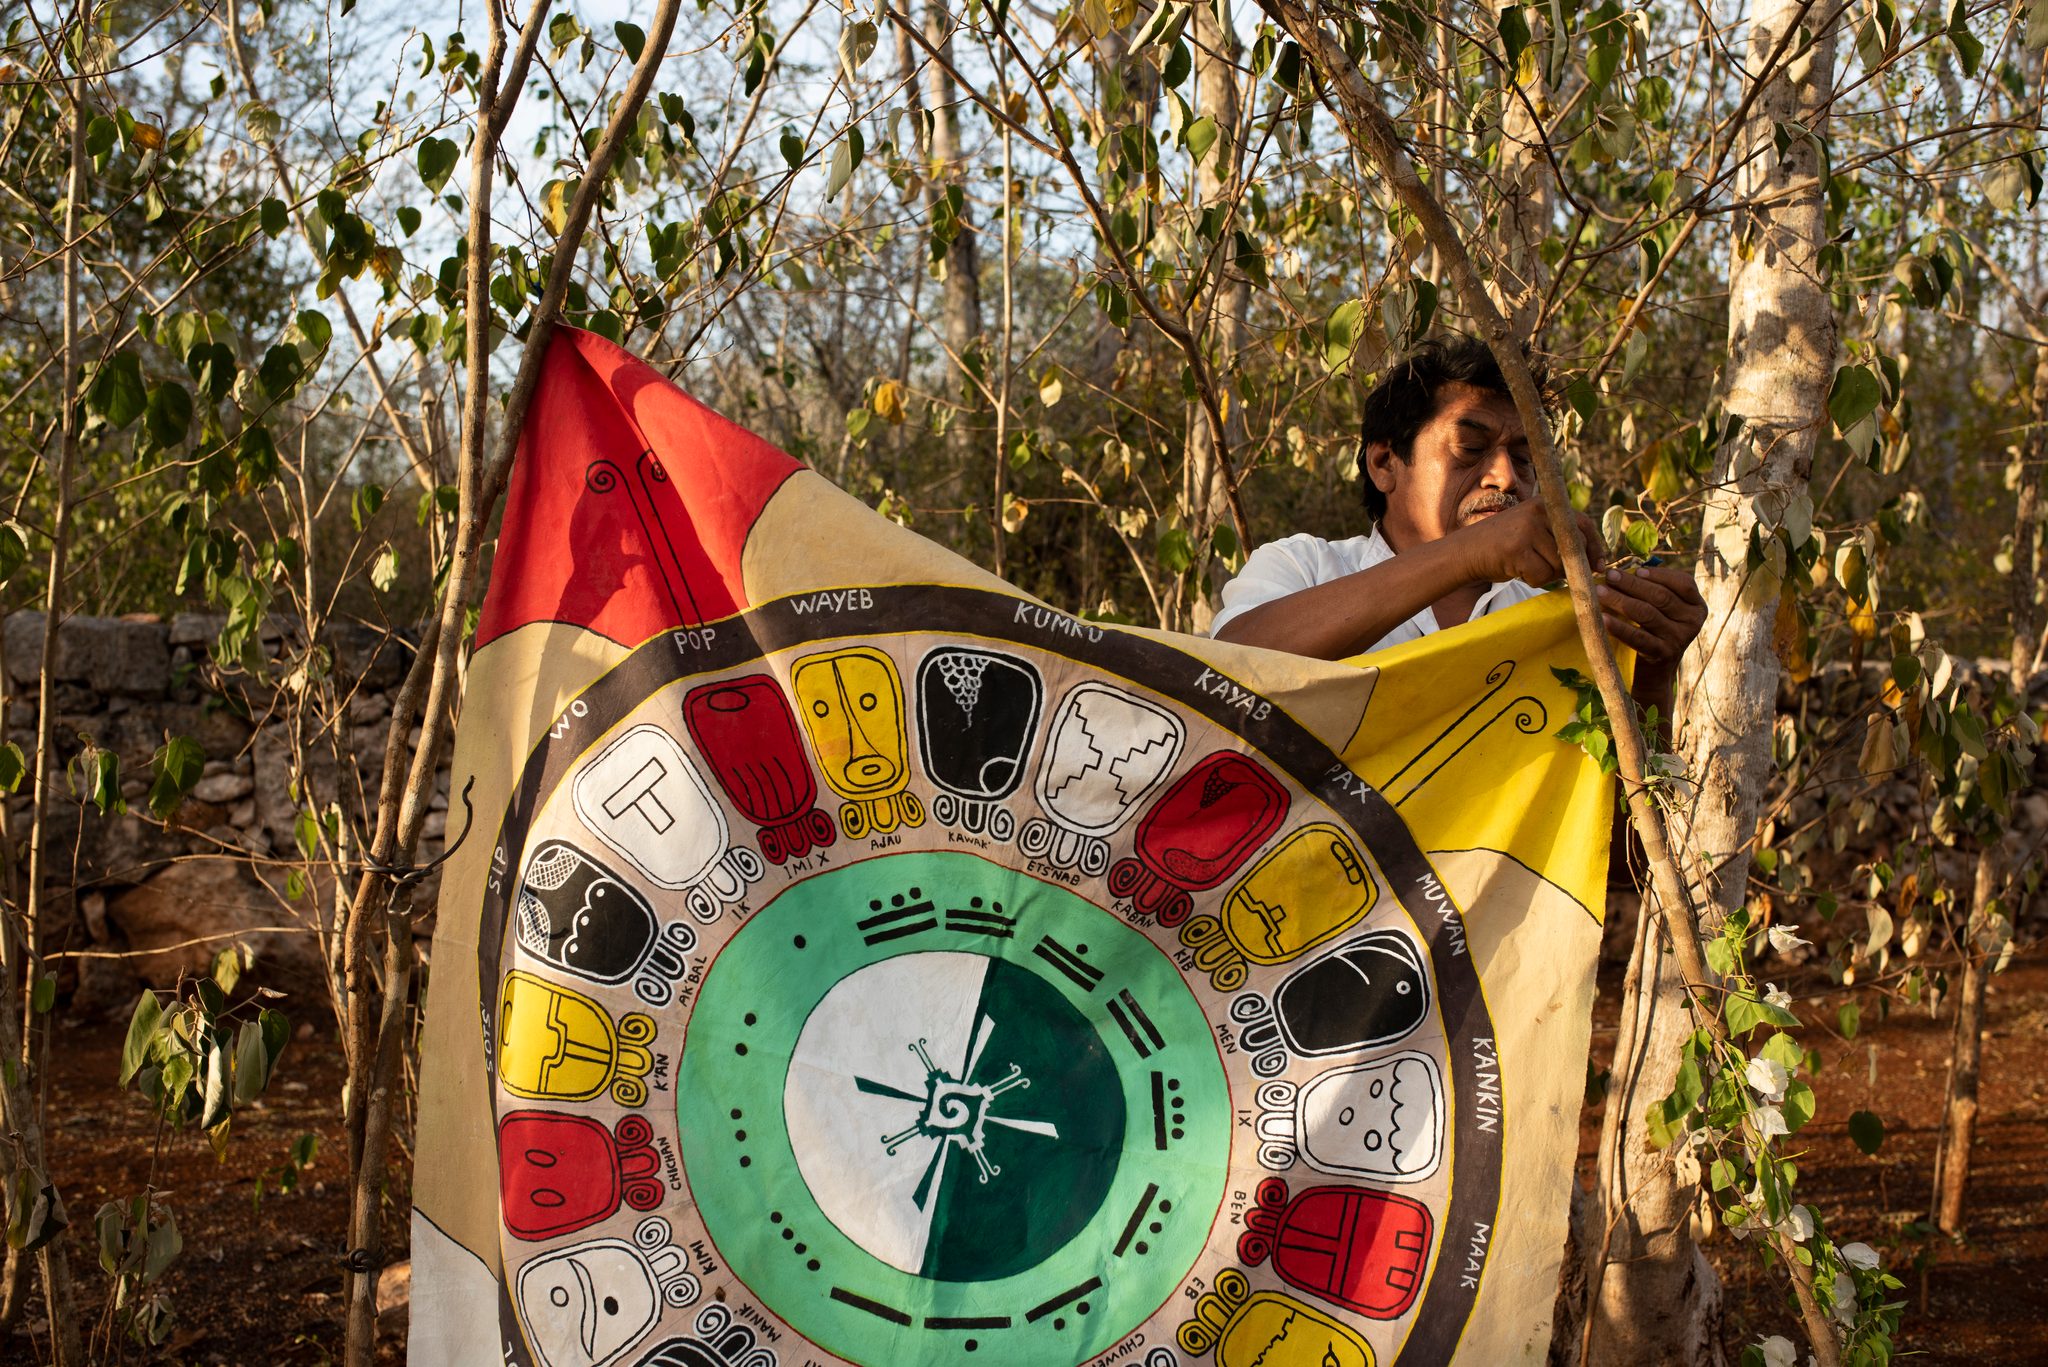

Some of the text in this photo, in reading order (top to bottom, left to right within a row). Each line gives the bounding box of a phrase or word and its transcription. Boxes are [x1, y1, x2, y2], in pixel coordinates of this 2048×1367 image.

[790, 589, 873, 615] WAYEB
[674, 629, 716, 654] POP
[1194, 668, 1272, 721] K'AYAB
[550, 699, 588, 739] WO
[1325, 763, 1370, 804] PAX
[870, 834, 901, 850] AJAU
[488, 846, 507, 895] SIP
[784, 851, 830, 879] IMIX
[1027, 860, 1079, 885] ETS'NAB
[1112, 900, 1156, 928] KABAN
[1416, 873, 1466, 957] MUWAN
[1173, 949, 1193, 971] KIB
[679, 955, 708, 1007] AK'BAL
[1216, 1024, 1237, 1054] MEN
[654, 1053, 669, 1091] K'AN
[1238, 1109, 1252, 1127] IX
[658, 1136, 681, 1191] CHICHAN
[689, 1240, 718, 1275] KIMI
[1460, 1222, 1489, 1289] MAAK
[1185, 1276, 1205, 1300] EB
[1092, 1333, 1145, 1367] CHUWE
